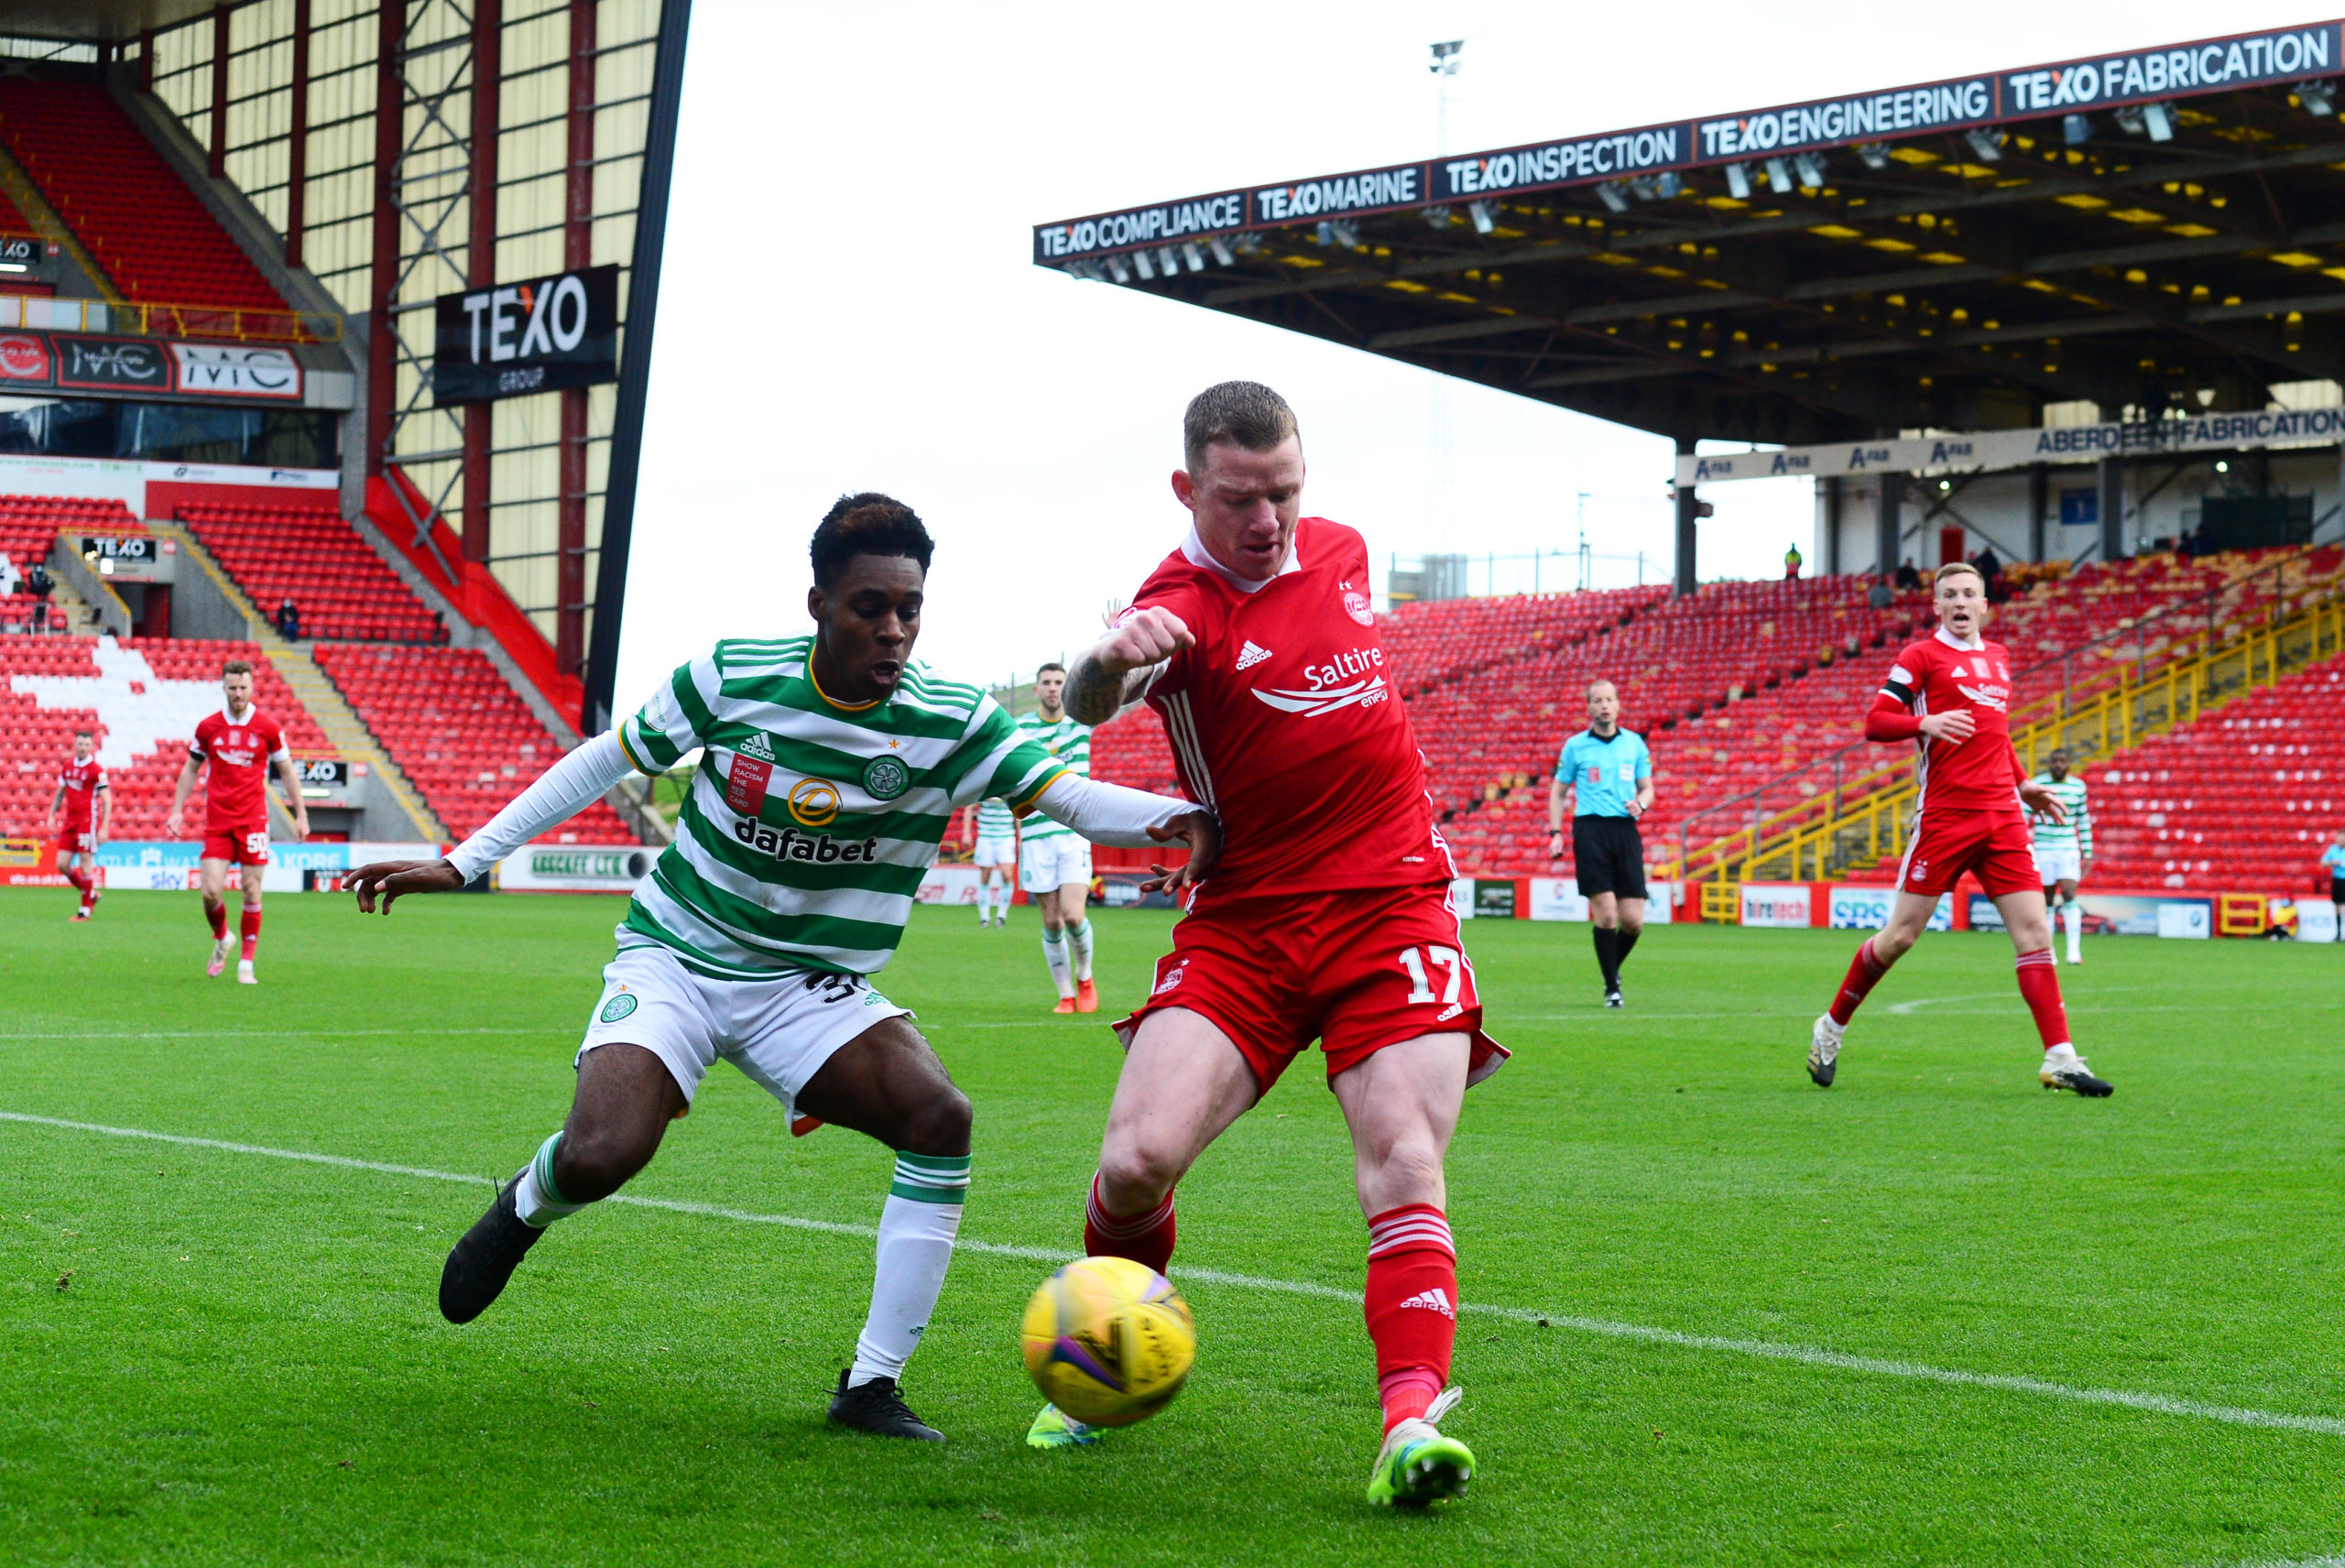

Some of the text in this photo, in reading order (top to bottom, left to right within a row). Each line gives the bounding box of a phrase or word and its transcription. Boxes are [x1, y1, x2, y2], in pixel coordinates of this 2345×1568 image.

[464, 276, 587, 365] TEXO
[499, 365, 545, 392] GROUP
[93, 539, 146, 557] TEXO
[1236, 649, 1273, 670] adidas
[1304, 648, 1384, 691] Saltire
[740, 743, 776, 761] adidas
[293, 761, 336, 781] EXO
[736, 758, 760, 772] SHOW
[734, 768, 764, 782] RACISM
[734, 776, 747, 788] THE
[731, 785, 746, 796] RED
[729, 795, 748, 808] CARD
[735, 817, 877, 864] dafabet
[151, 871, 183, 890] sky
[1399, 946, 1461, 1005] 17
[1400, 1301, 1455, 1320] adidas
